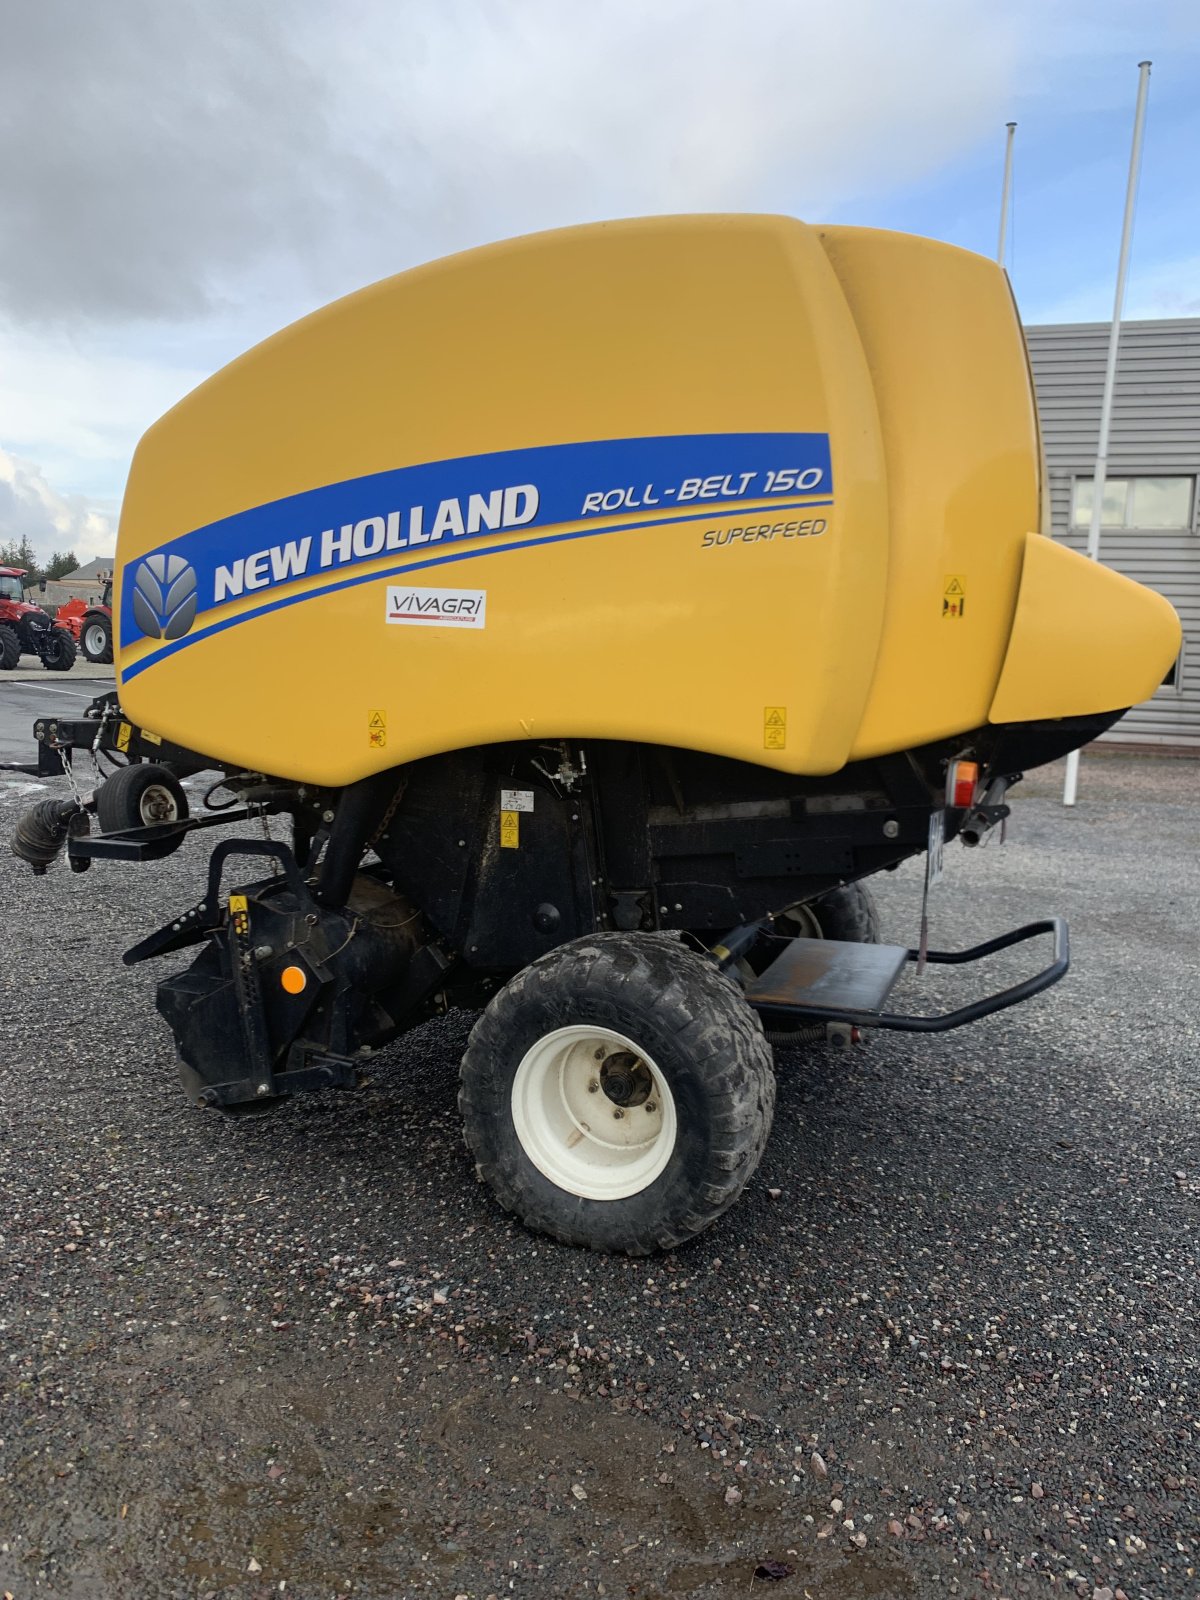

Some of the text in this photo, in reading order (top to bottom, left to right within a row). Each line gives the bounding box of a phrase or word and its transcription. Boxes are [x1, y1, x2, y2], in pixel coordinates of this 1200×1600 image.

[763, 468, 823, 493] 150
[214, 484, 540, 603] NEW HOLLAND
[702, 518, 827, 548] SUPERFEED
